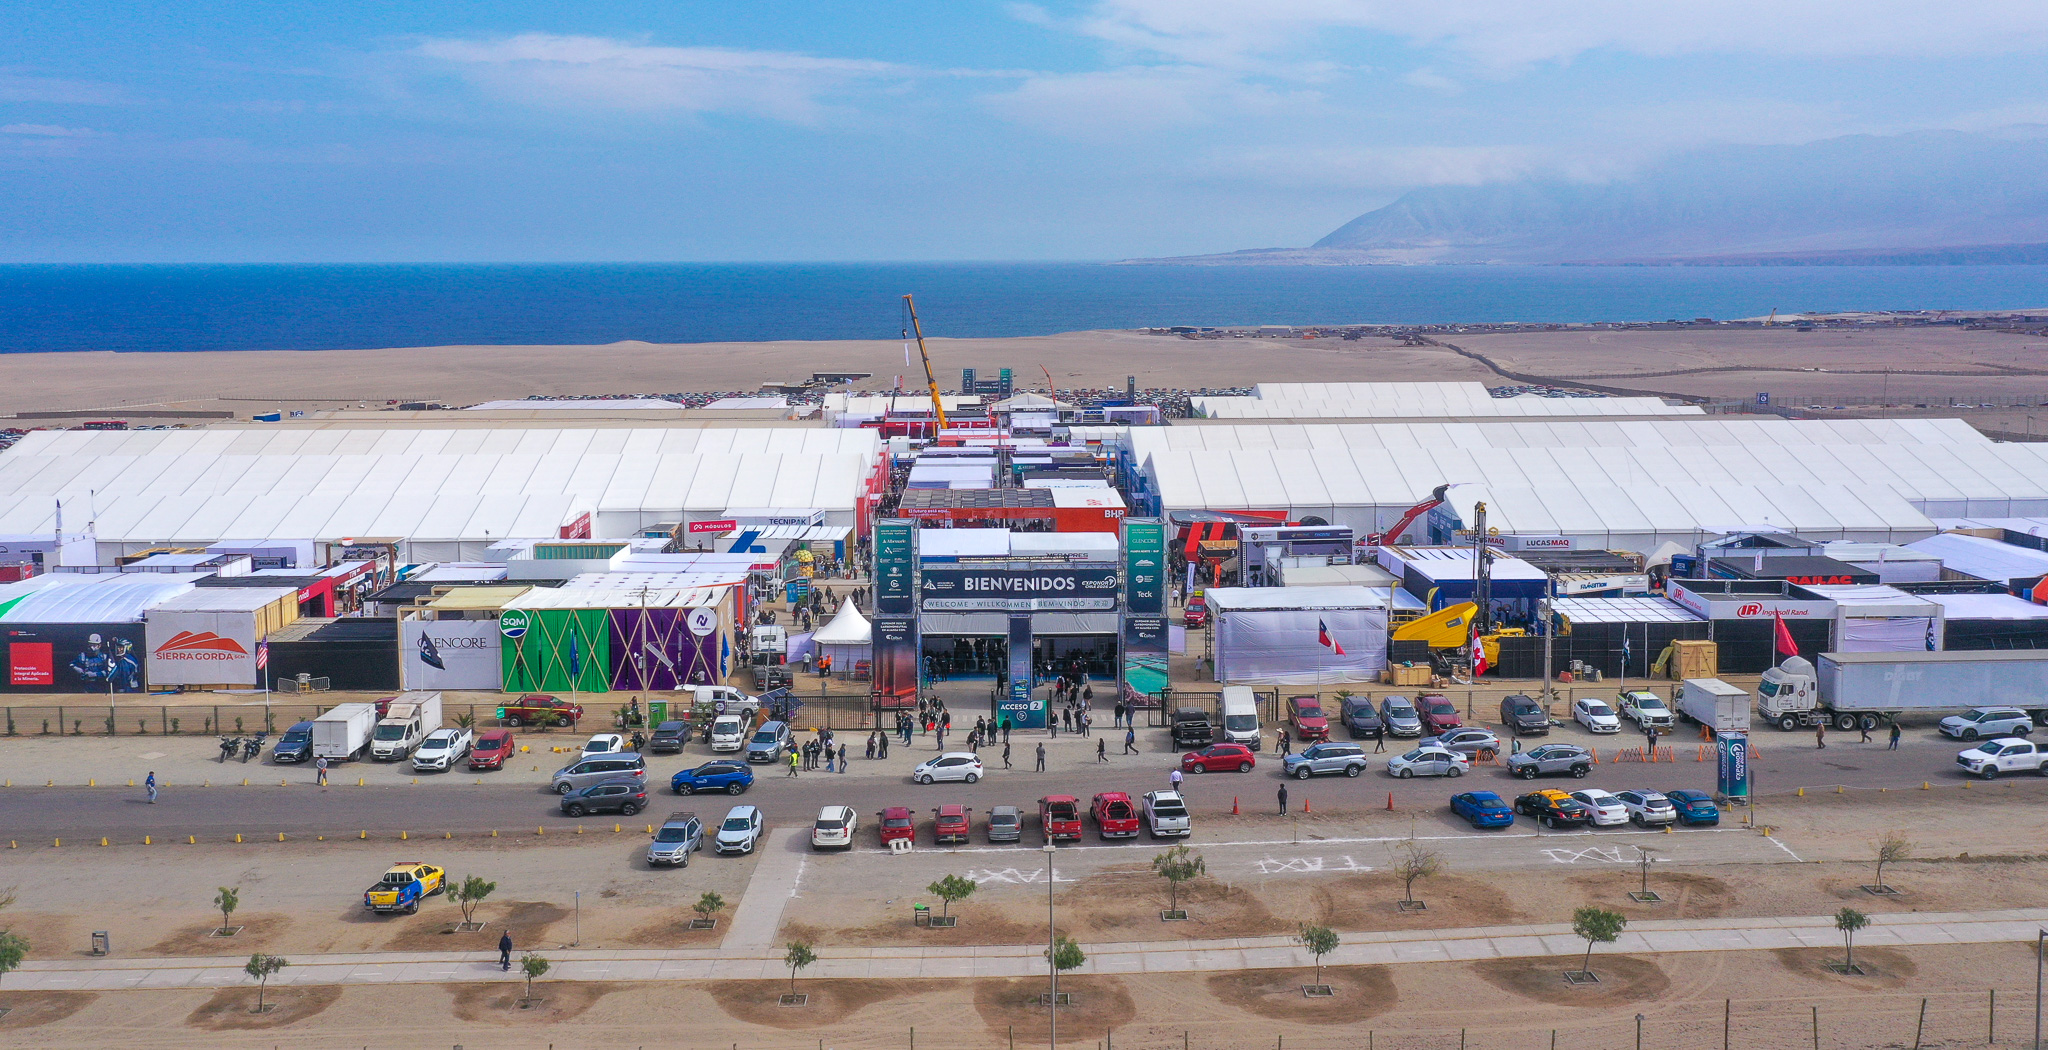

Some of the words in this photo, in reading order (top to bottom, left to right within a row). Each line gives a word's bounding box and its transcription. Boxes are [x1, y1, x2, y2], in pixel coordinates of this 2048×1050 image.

[1104, 509, 1125, 519] BHP
[768, 518, 807, 526] TECNIPAK
[1526, 539, 1569, 547] LUCASMAQ
[964, 577, 1075, 591] BIENVENIDOS
[502, 617, 525, 627] SQM
[156, 652, 194, 660] SIERRA
[195, 652, 234, 660] GORDA
[1033, 701, 1039, 710] 2
